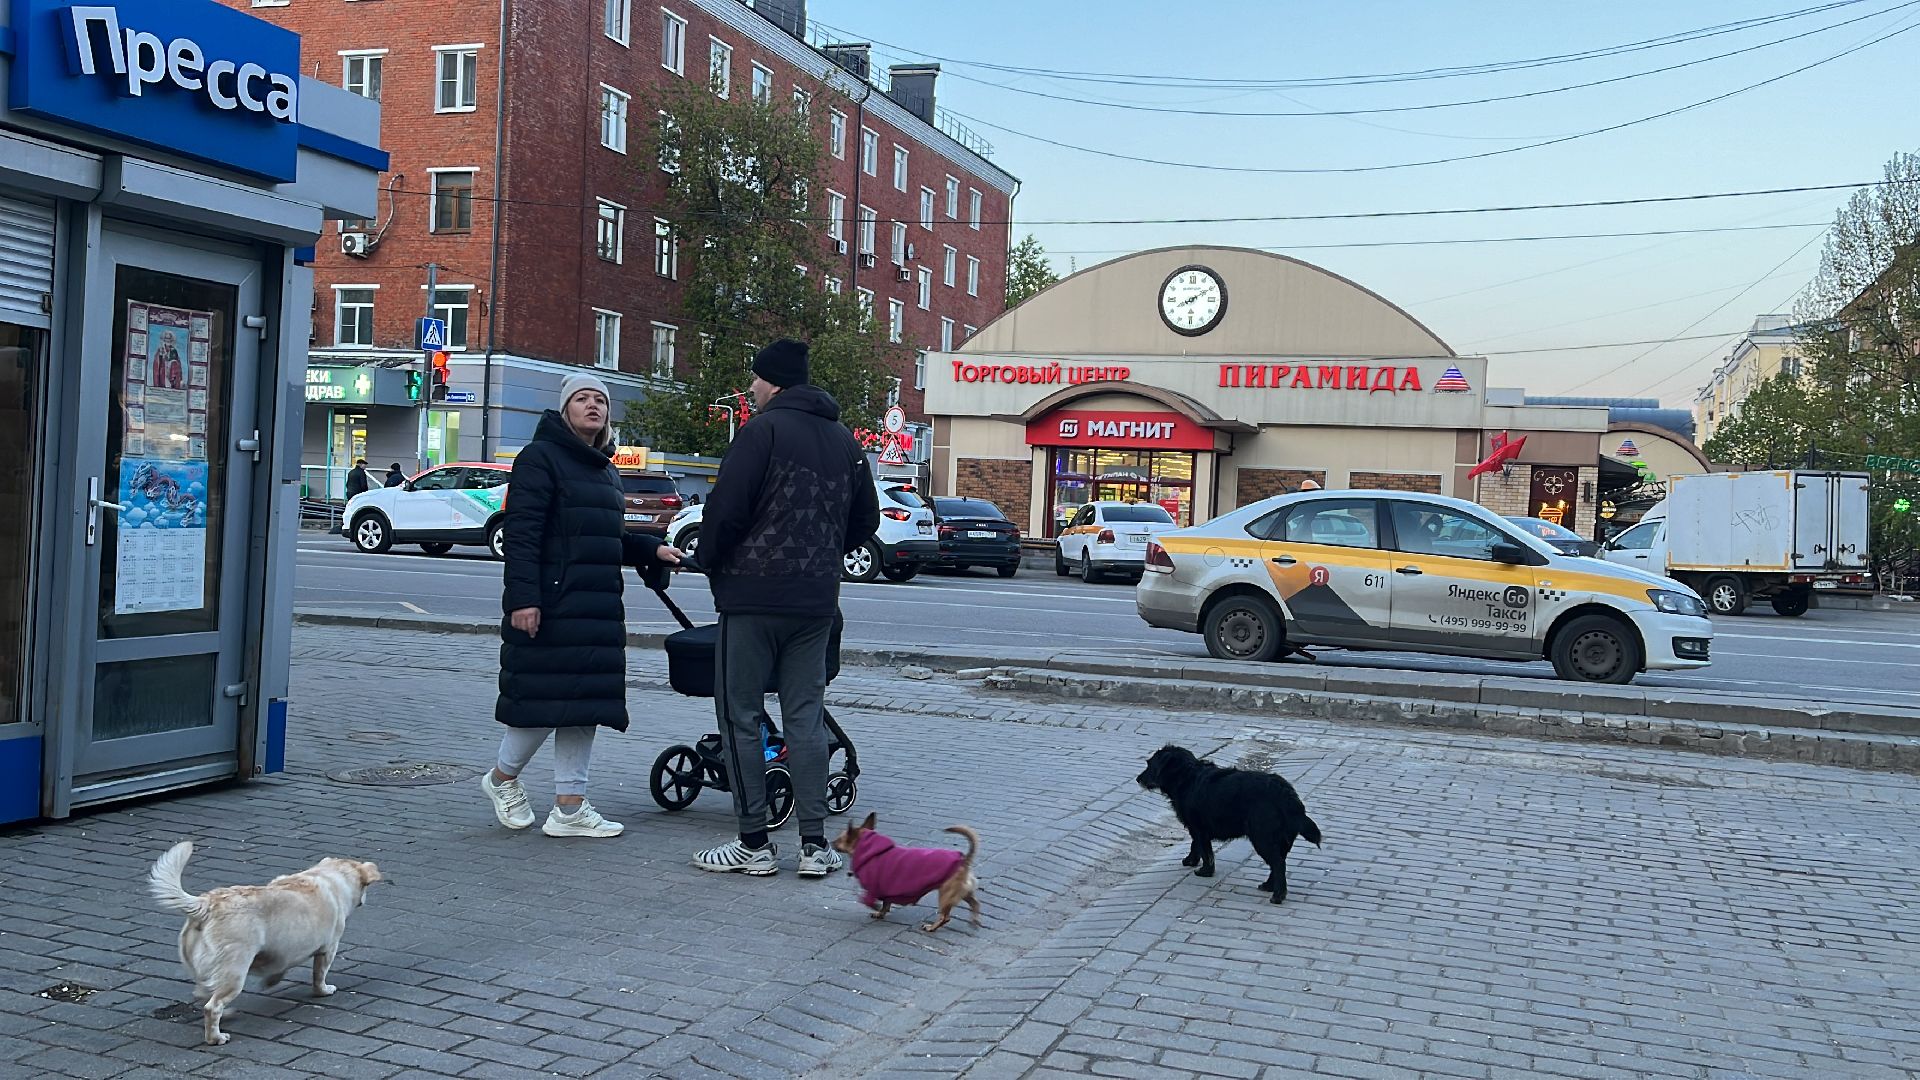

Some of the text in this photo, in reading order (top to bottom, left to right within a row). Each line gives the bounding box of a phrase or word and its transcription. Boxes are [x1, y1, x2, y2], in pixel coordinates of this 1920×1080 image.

[71, 6, 297, 123] Пресса
[1068, 366, 1131, 384] ЦЕНТР
[1218, 365, 1423, 396] ПИРАМИДА
[892, 415, 898, 425] 5
[1087, 420, 1175, 438] МАГНИТ
[1313, 567, 1325, 583] Я
[1364, 573, 1384, 588] 611
[1448, 584, 1527, 605] Яндекс Go
[1486, 604, 1527, 621] Такси
[1440, 614, 1527, 632] (495) 999-99-99
